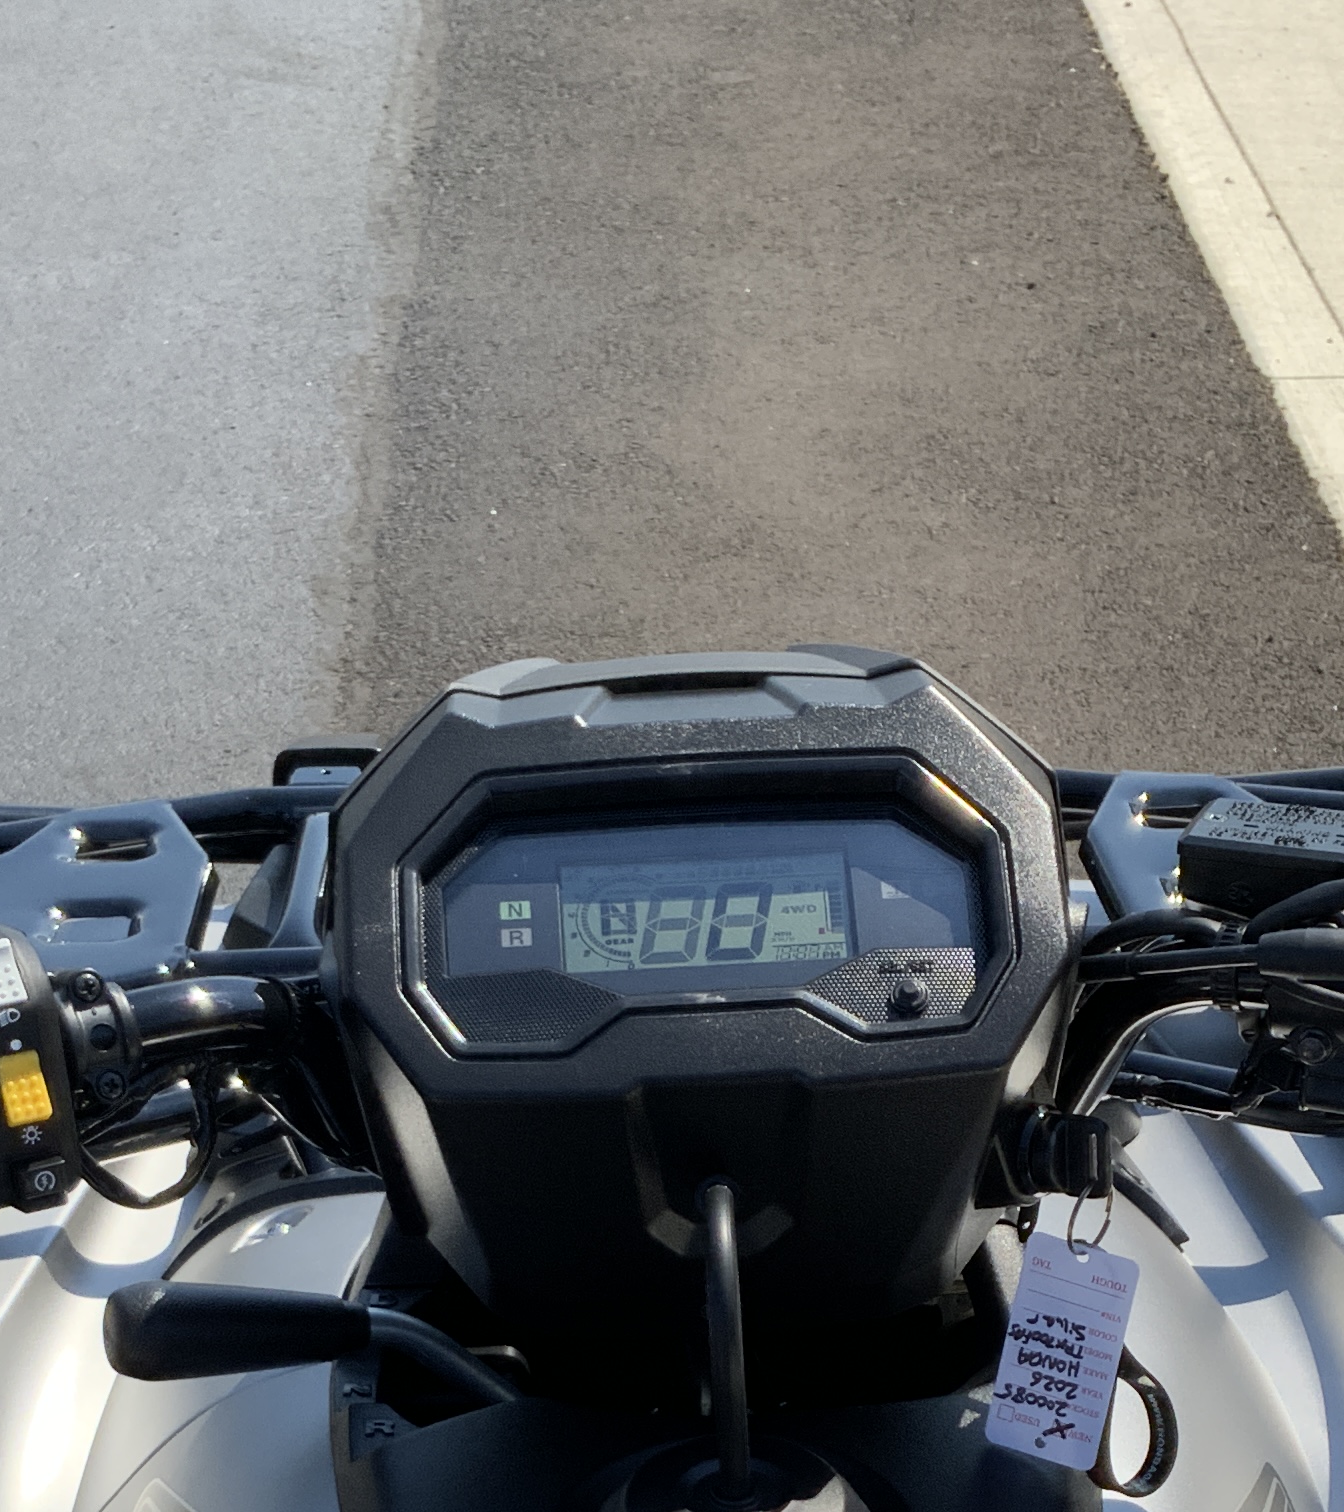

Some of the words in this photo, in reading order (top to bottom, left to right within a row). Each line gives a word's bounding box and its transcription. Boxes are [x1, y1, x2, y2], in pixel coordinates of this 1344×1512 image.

[508, 903, 522, 917] N
[781, 904, 816, 914] 4WD
[510, 931, 524, 945] R
[1032, 1257, 1051, 1270] TAG
[1091, 1275, 1127, 1292] TOUGH
[1088, 1327, 1117, 1342] COLOR
[1018, 1347, 1080, 1377] HONDA
[1083, 1366, 1108, 1380] MAKE
[1030, 1371, 1078, 1399] 2026
[1080, 1387, 1103, 1400] YEAR
[1014, 1412, 1040, 1427] USED
